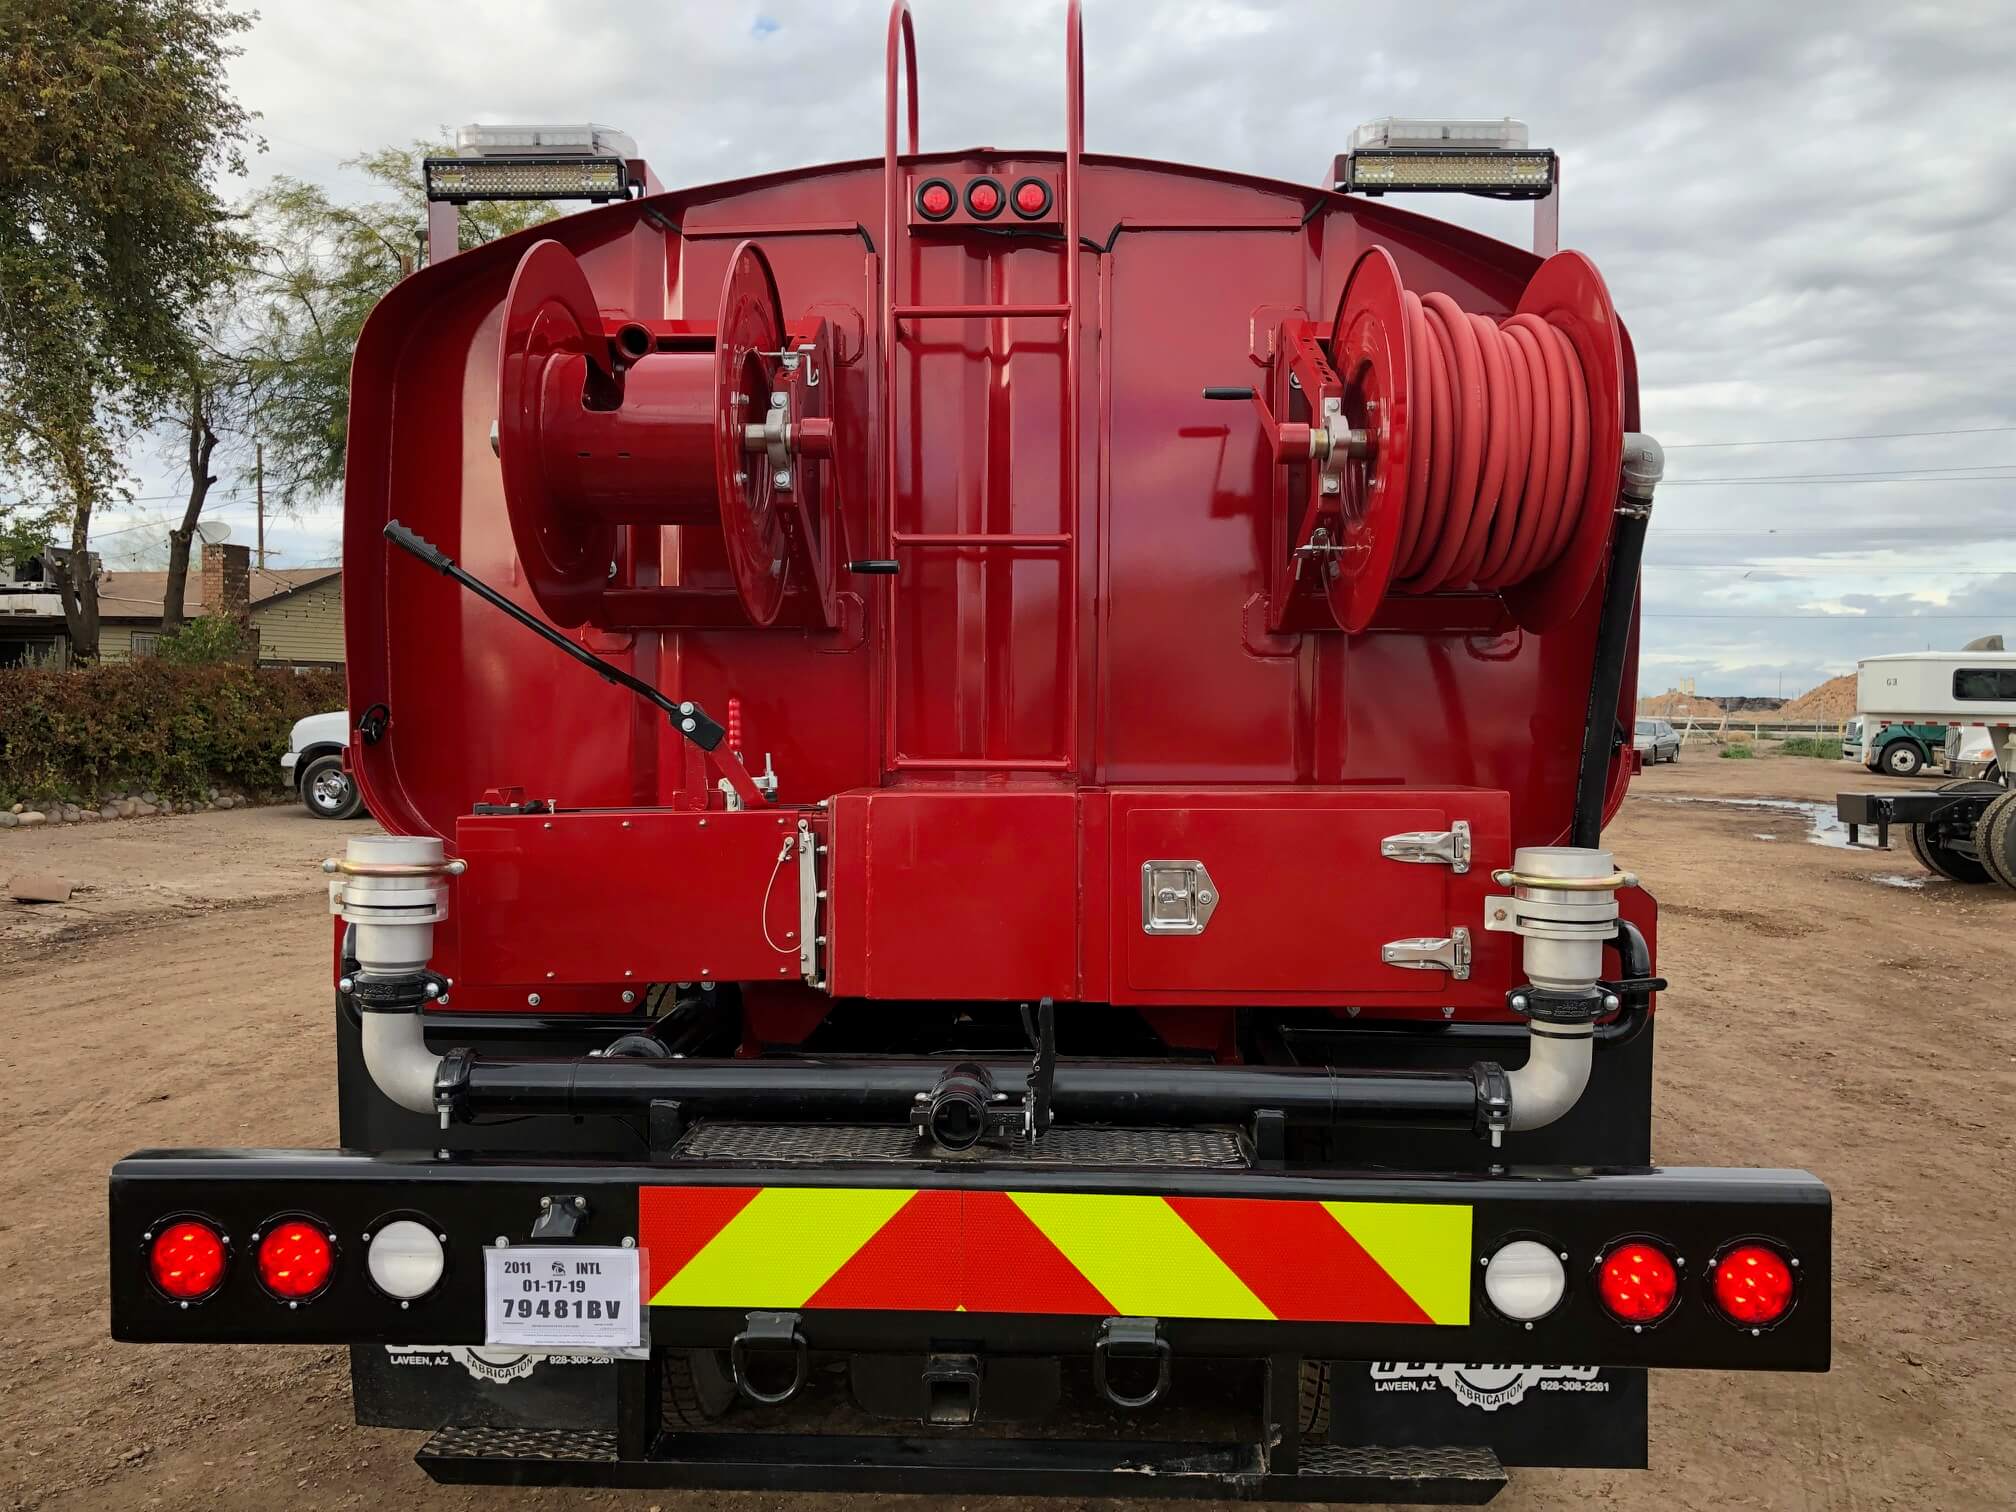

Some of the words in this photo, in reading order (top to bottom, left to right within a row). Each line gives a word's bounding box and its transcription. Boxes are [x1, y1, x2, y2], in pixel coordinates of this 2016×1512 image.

[504, 1261, 531, 1274] 2011
[576, 1262, 602, 1275] INTL
[523, 1279, 586, 1293] 01-17-19
[502, 1299, 621, 1319] 79481BV
[390, 1355, 432, 1367] LAVEEN,
[434, 1355, 449, 1366] AZ
[466, 1354, 533, 1379] FABRICATION
[1374, 1381, 1419, 1392] LAVEEN,
[1421, 1381, 1437, 1391] AZ
[1455, 1378, 1523, 1405] FABRICATION
